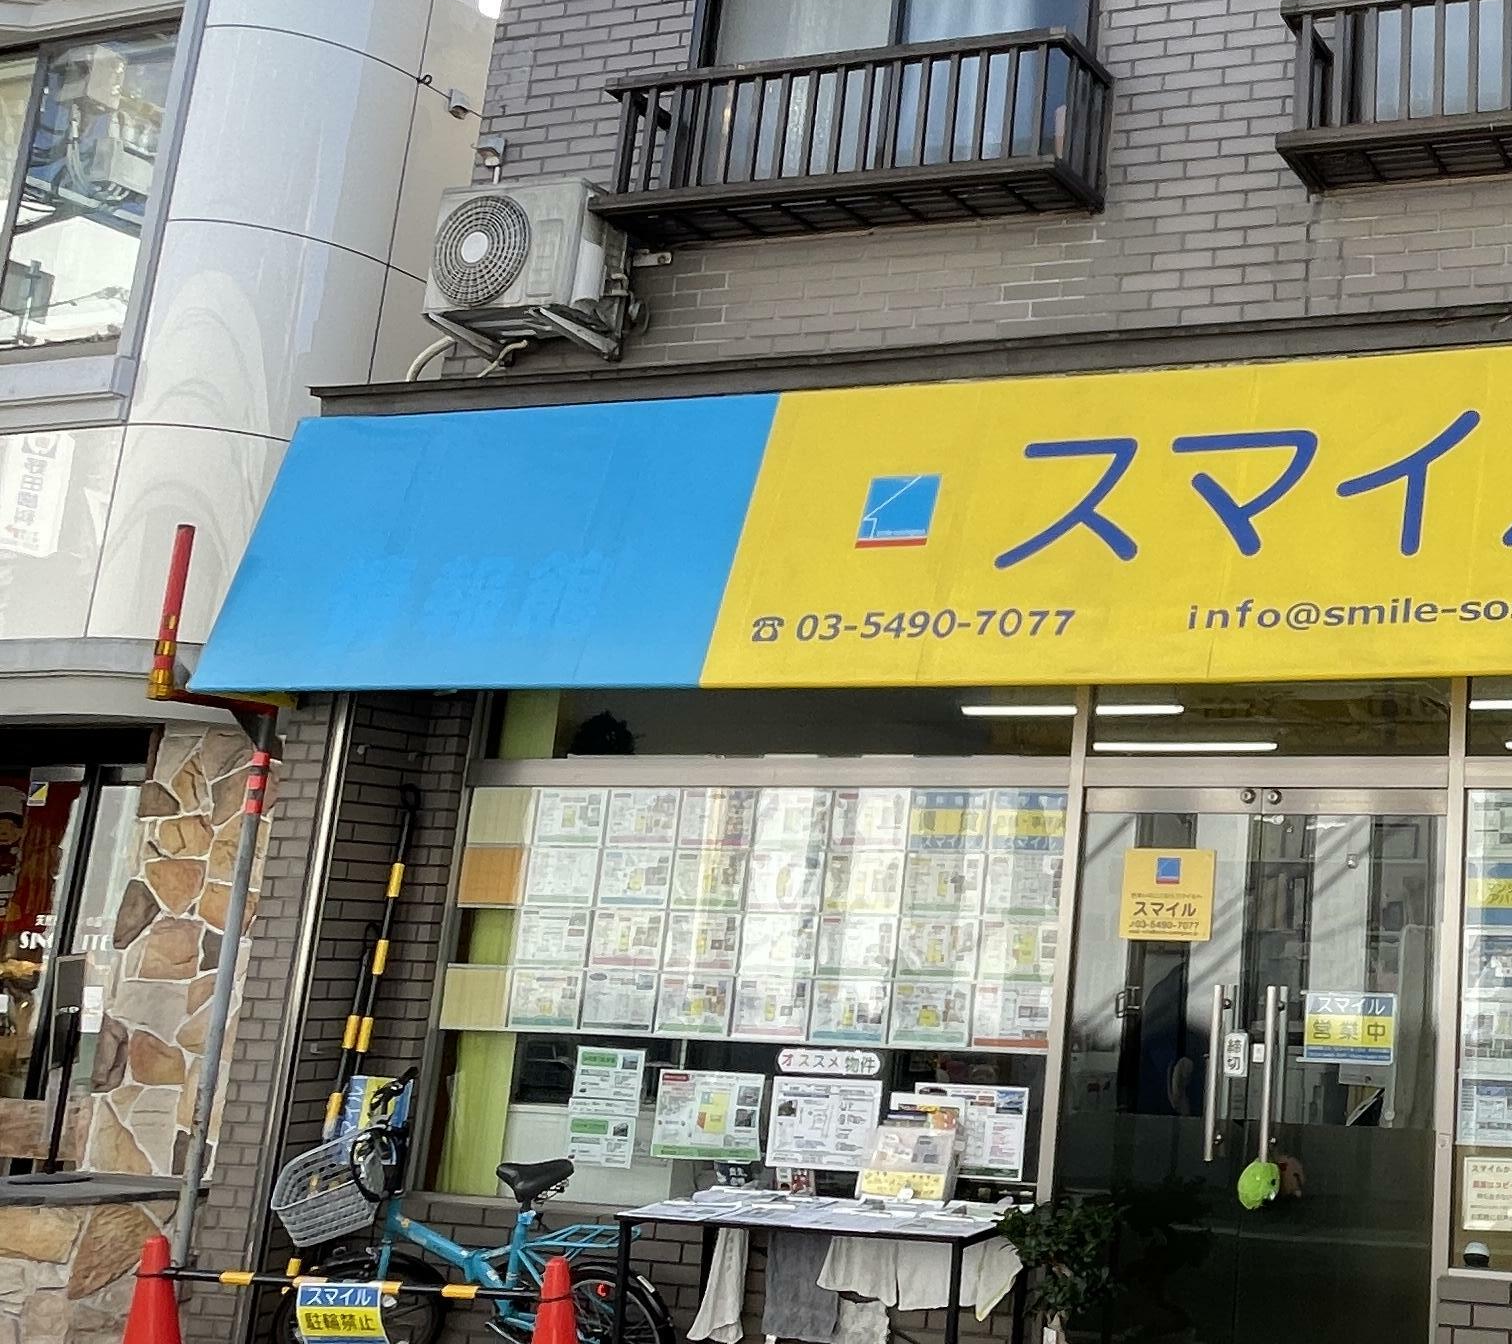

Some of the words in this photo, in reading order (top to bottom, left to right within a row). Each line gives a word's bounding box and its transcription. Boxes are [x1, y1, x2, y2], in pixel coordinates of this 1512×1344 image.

[795, 608, 1077, 644] 03-5490-7077
[1132, 901, 1197, 917] スマイル
[1316, 996, 1386, 1015] スマイル
[1312, 1018, 1386, 1043] 営業中
[781, 1052, 877, 1074] オススメ物件
[306, 1287, 372, 1306] スマイル
[304, 1312, 376, 1332] 駐輪禁止
